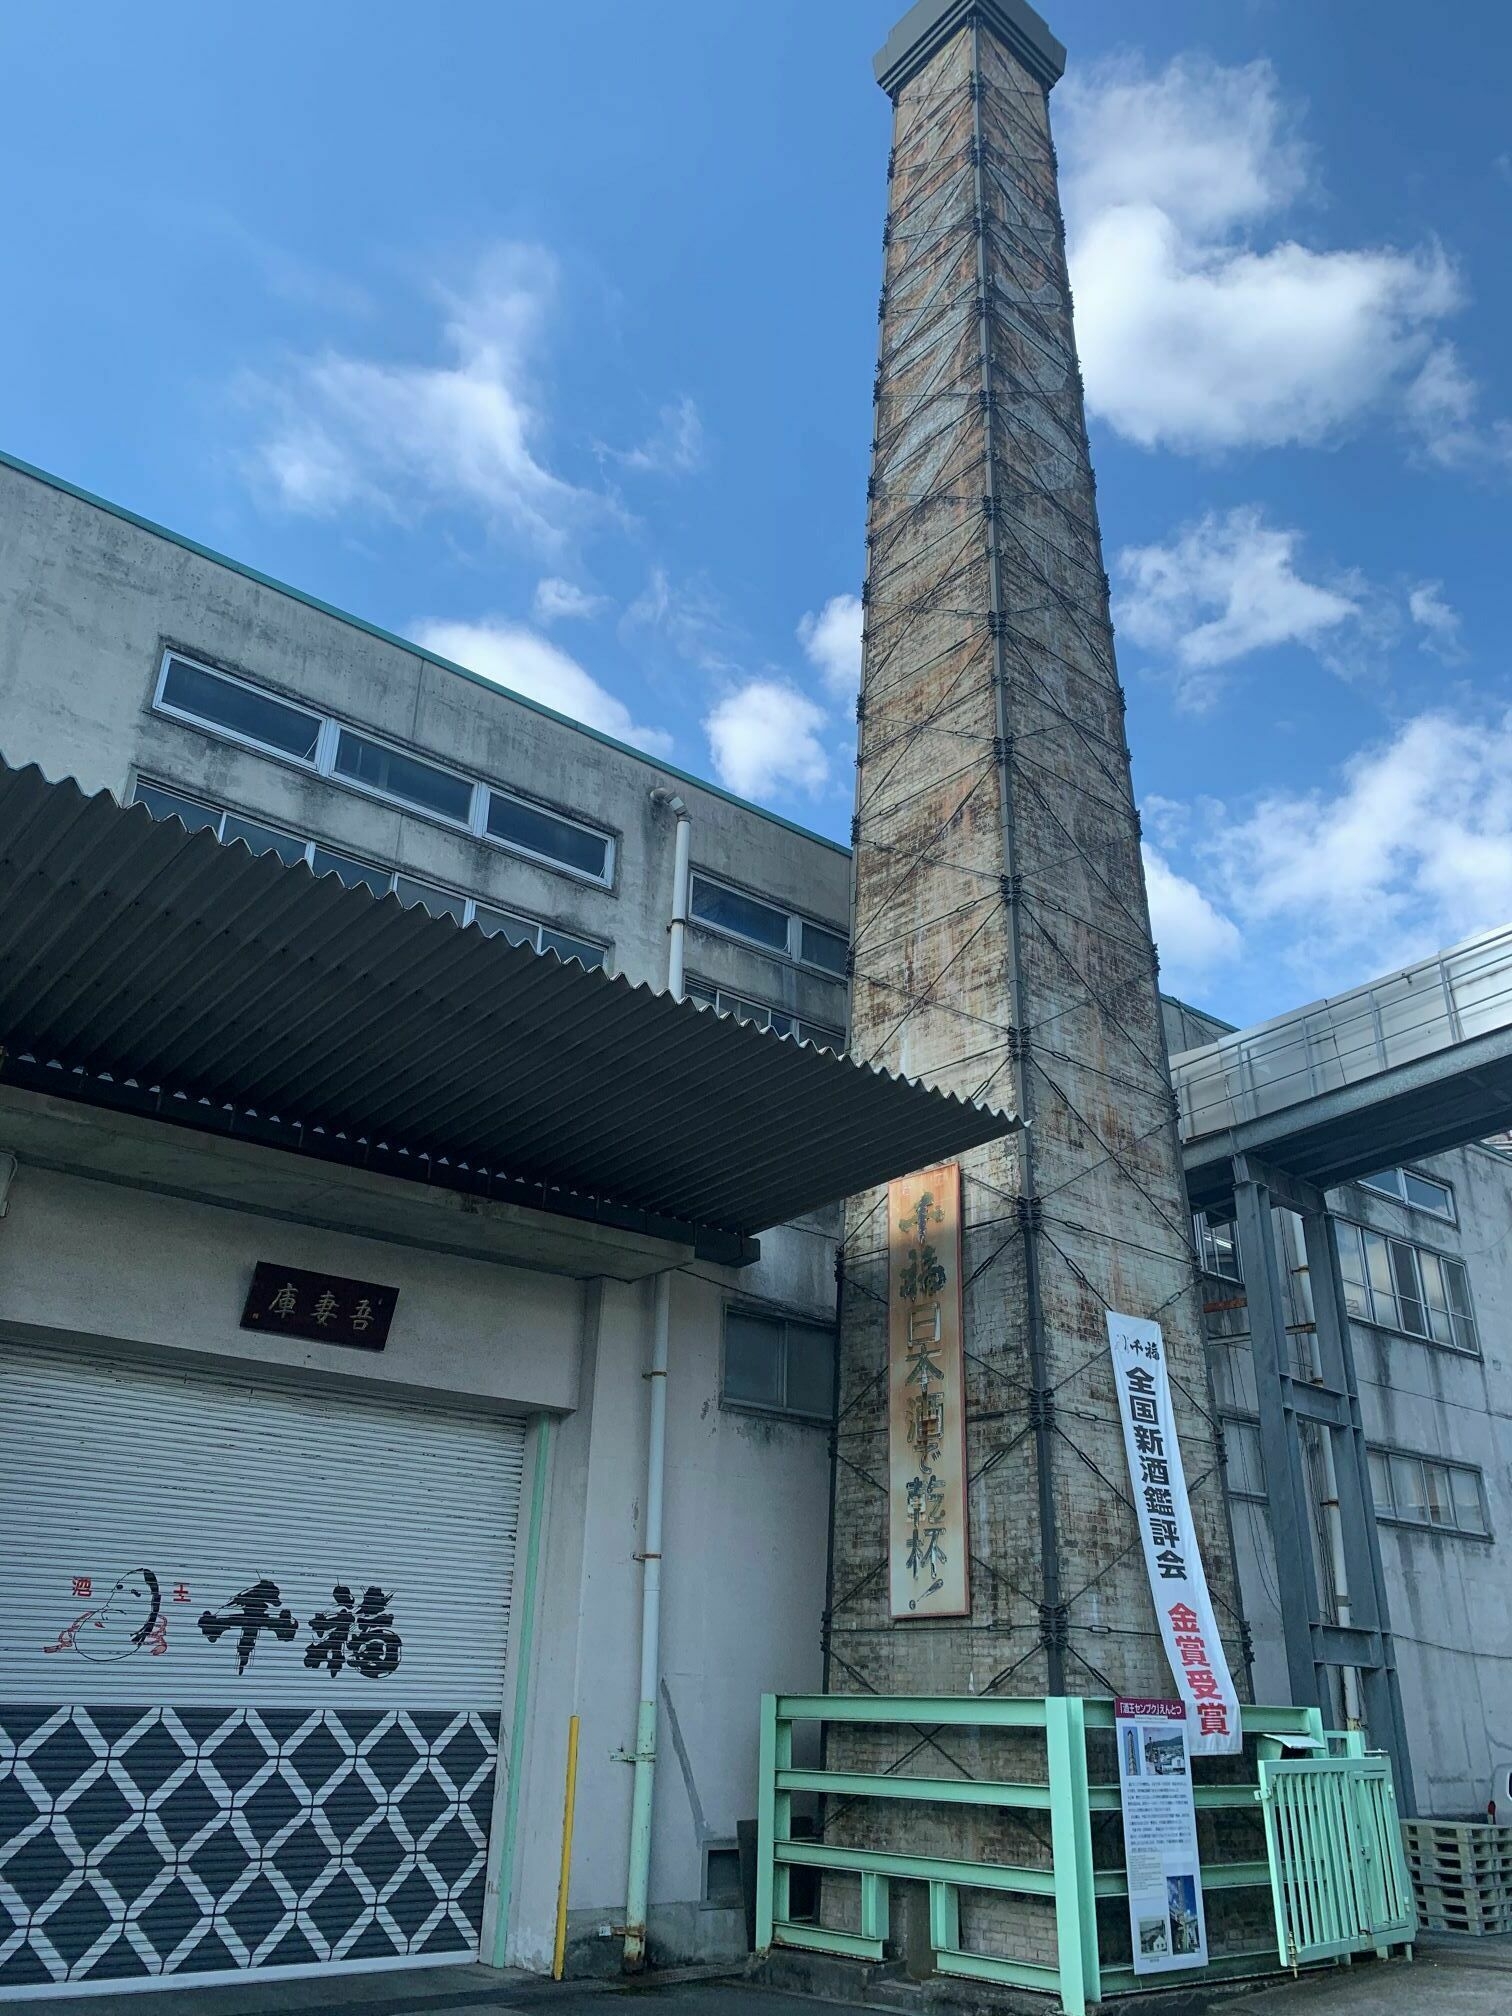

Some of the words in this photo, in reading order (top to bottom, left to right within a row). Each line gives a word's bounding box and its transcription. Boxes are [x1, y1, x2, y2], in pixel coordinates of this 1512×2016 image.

[1129, 1338, 1161, 1361] 千福
[1125, 1367, 1188, 1581] 全国新酒鑑評会
[1168, 1602, 1230, 1737] 金賞受賞
